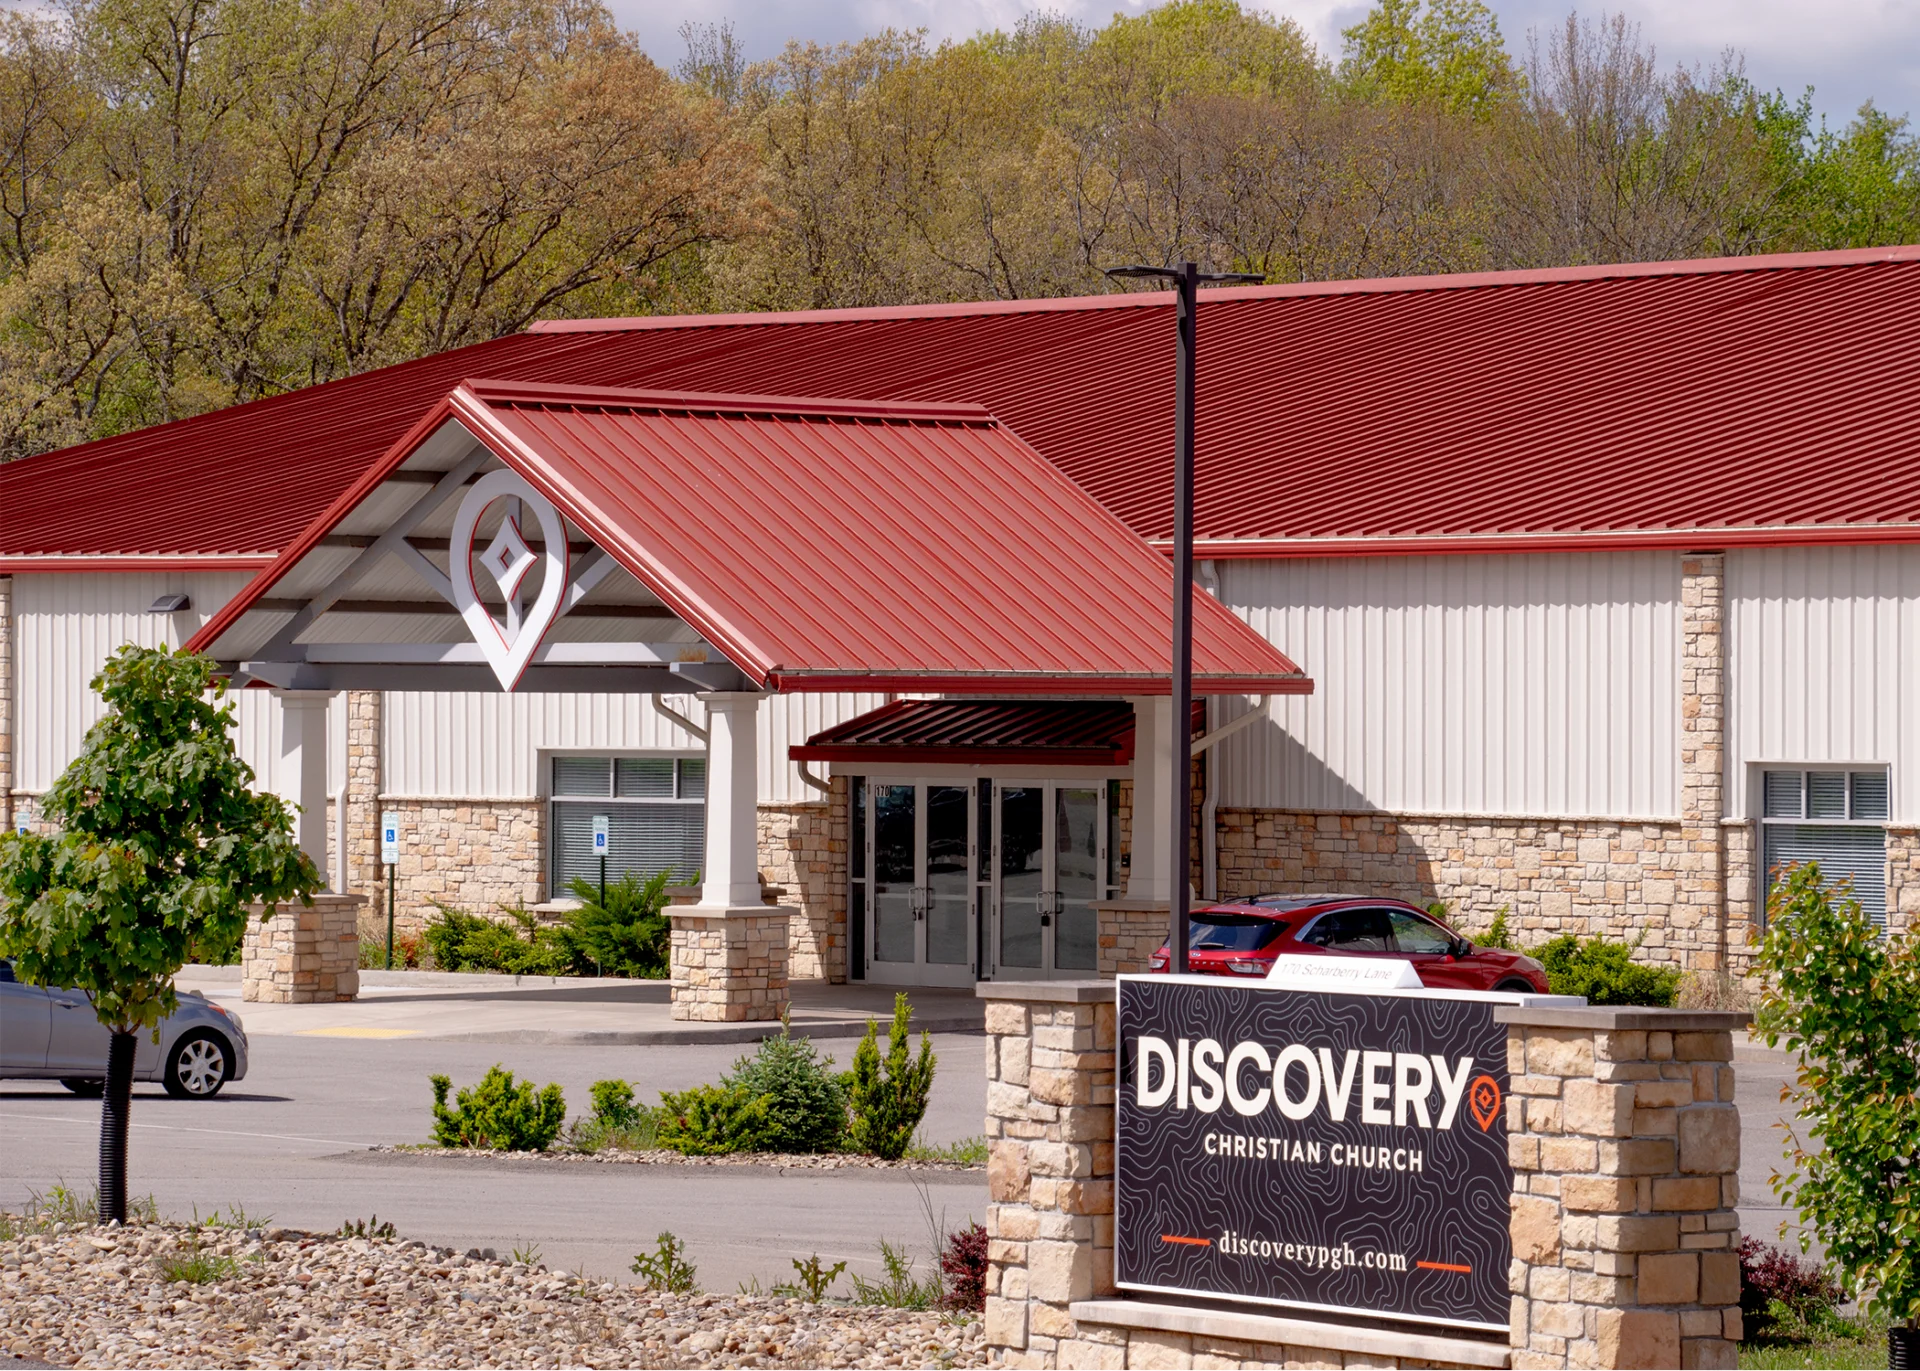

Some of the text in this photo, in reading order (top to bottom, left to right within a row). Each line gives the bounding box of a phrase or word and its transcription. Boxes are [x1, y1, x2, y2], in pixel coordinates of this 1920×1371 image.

[876, 786, 890, 797] 170
[1282, 963, 1393, 981] 170 Scharberry Lane
[1136, 1036, 1474, 1130] DISCOVERY
[1204, 1132, 1423, 1173] CHRISTIAN CHURCH
[1219, 1230, 1407, 1272] discoverypgh.com
